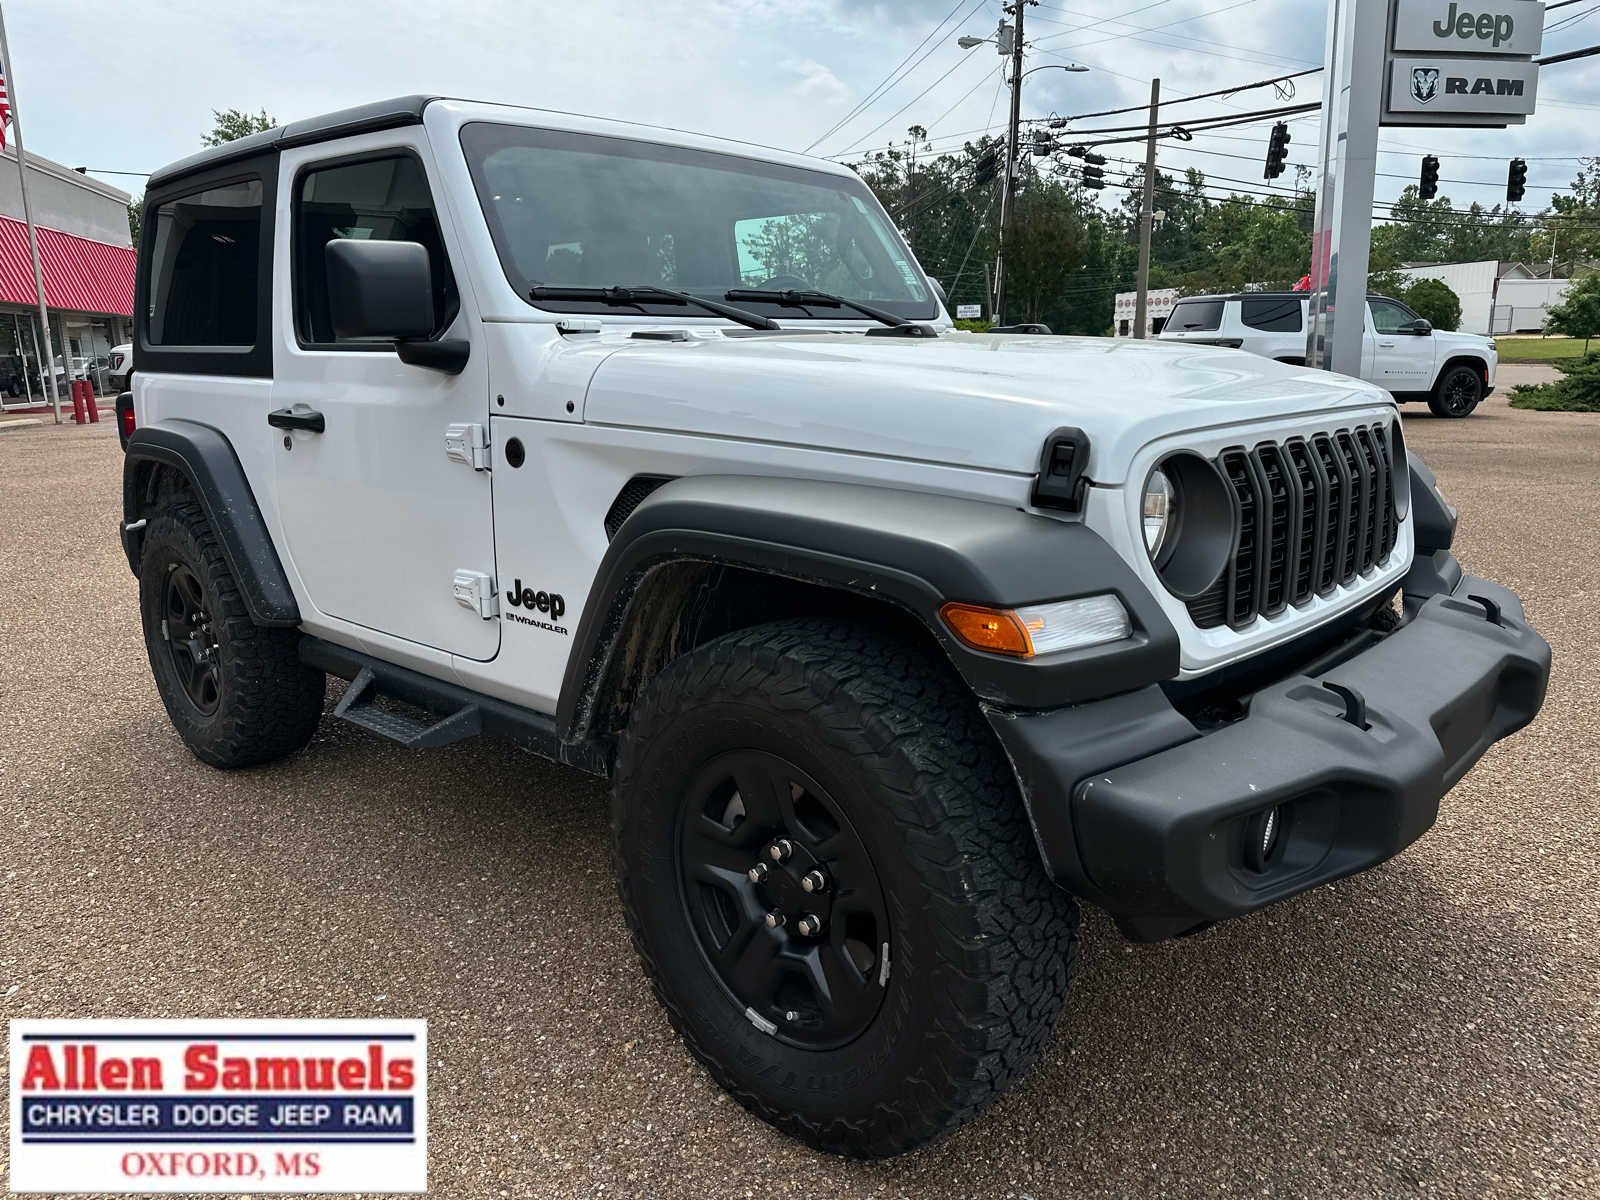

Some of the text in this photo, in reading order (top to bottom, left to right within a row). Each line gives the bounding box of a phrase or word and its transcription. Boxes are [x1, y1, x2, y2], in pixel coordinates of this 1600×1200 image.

[1433, 2, 1514, 47] Jeep
[1445, 77, 1524, 96] RAM
[506, 578, 565, 621] Jeep
[515, 614, 568, 635] WRANGLER
